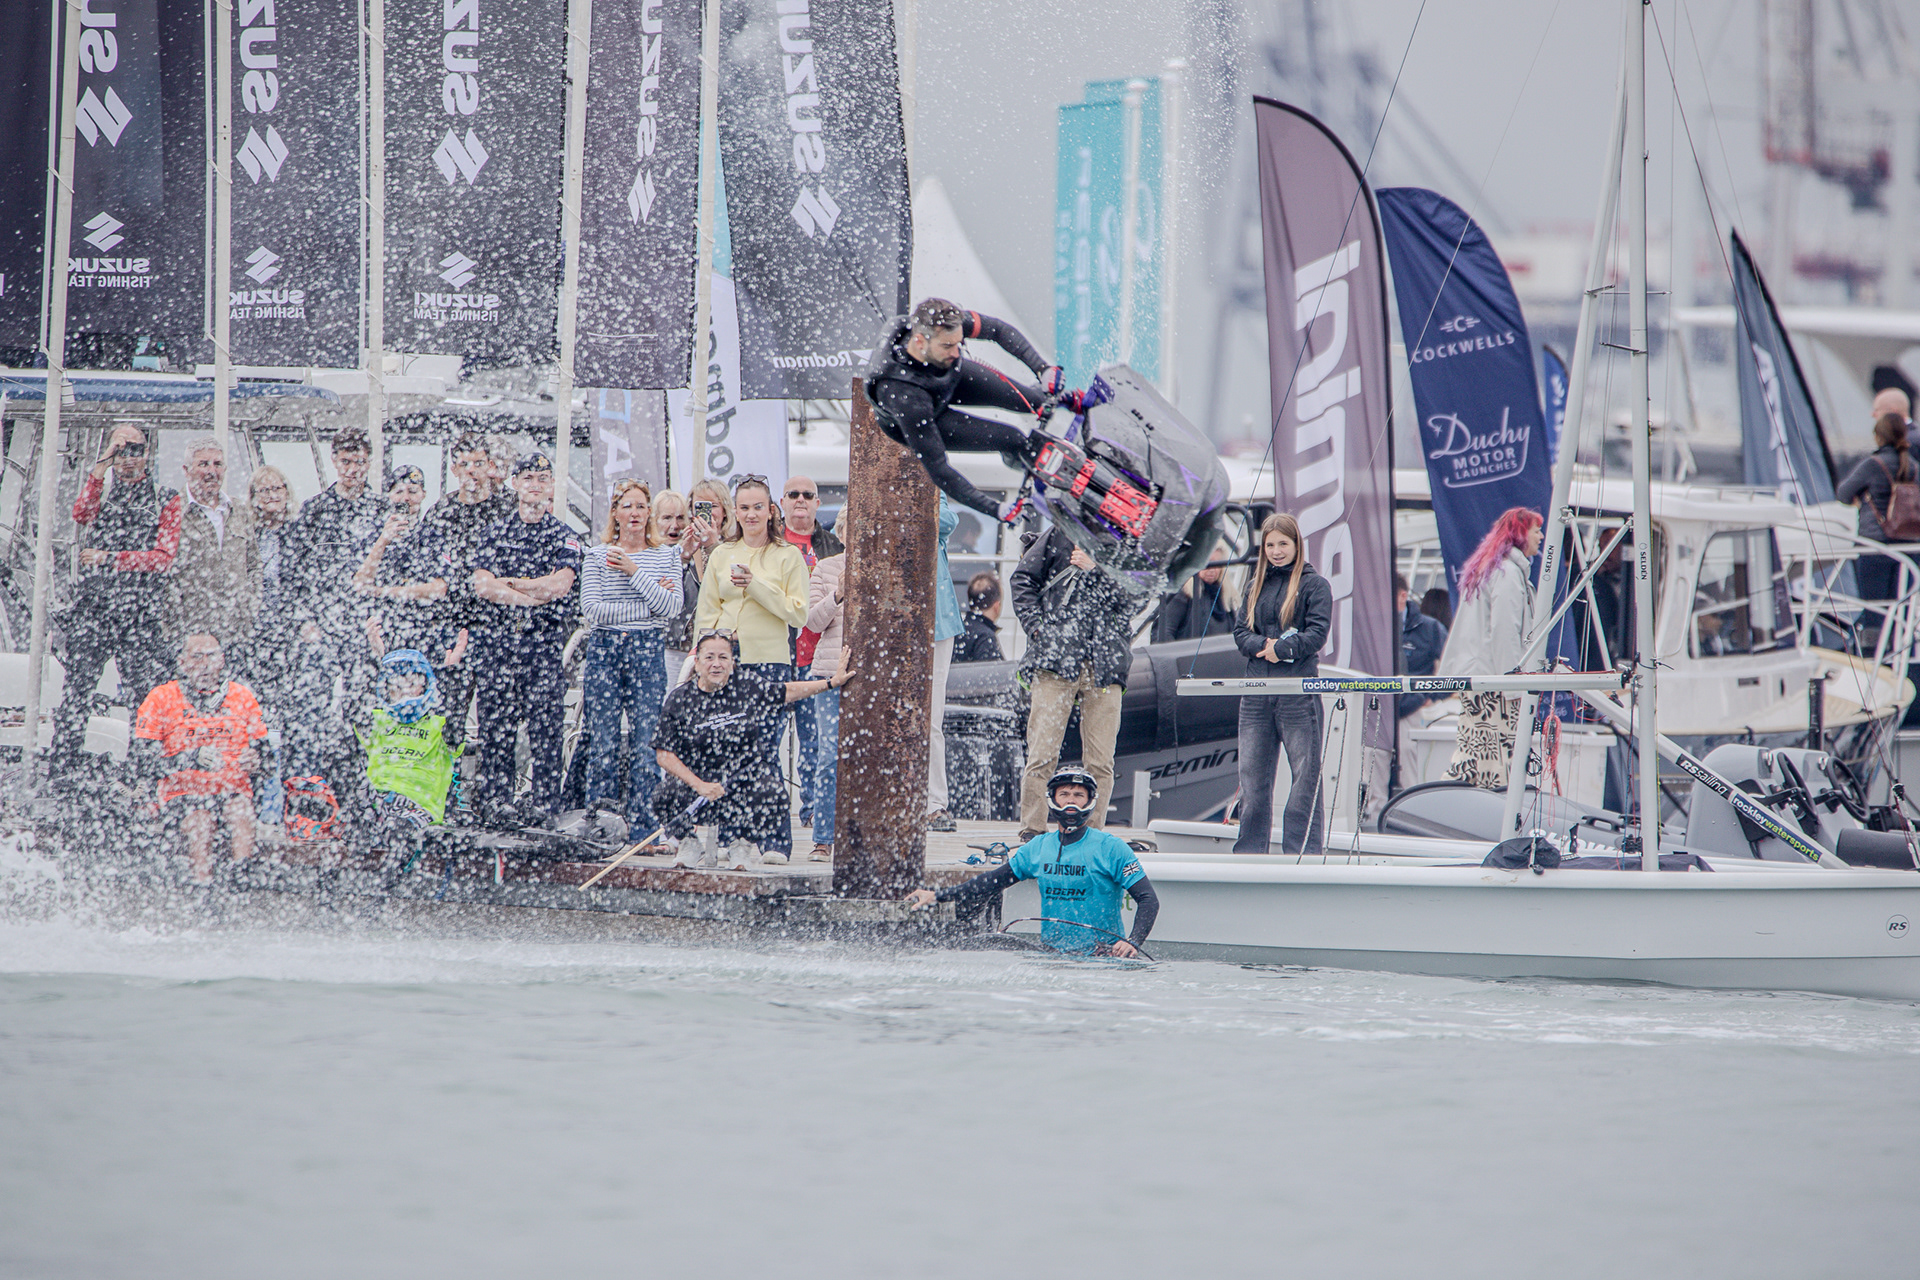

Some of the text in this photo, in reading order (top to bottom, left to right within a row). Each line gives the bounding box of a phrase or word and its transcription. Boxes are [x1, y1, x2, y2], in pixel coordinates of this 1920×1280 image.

[1413, 331, 1516, 363] COCKWELLS
[1427, 406, 1531, 462] Duchy
[1453, 447, 1516, 470] MOTOR
[1455, 460, 1518, 480] LAUNCHES
[1888, 921, 1908, 931] RS
